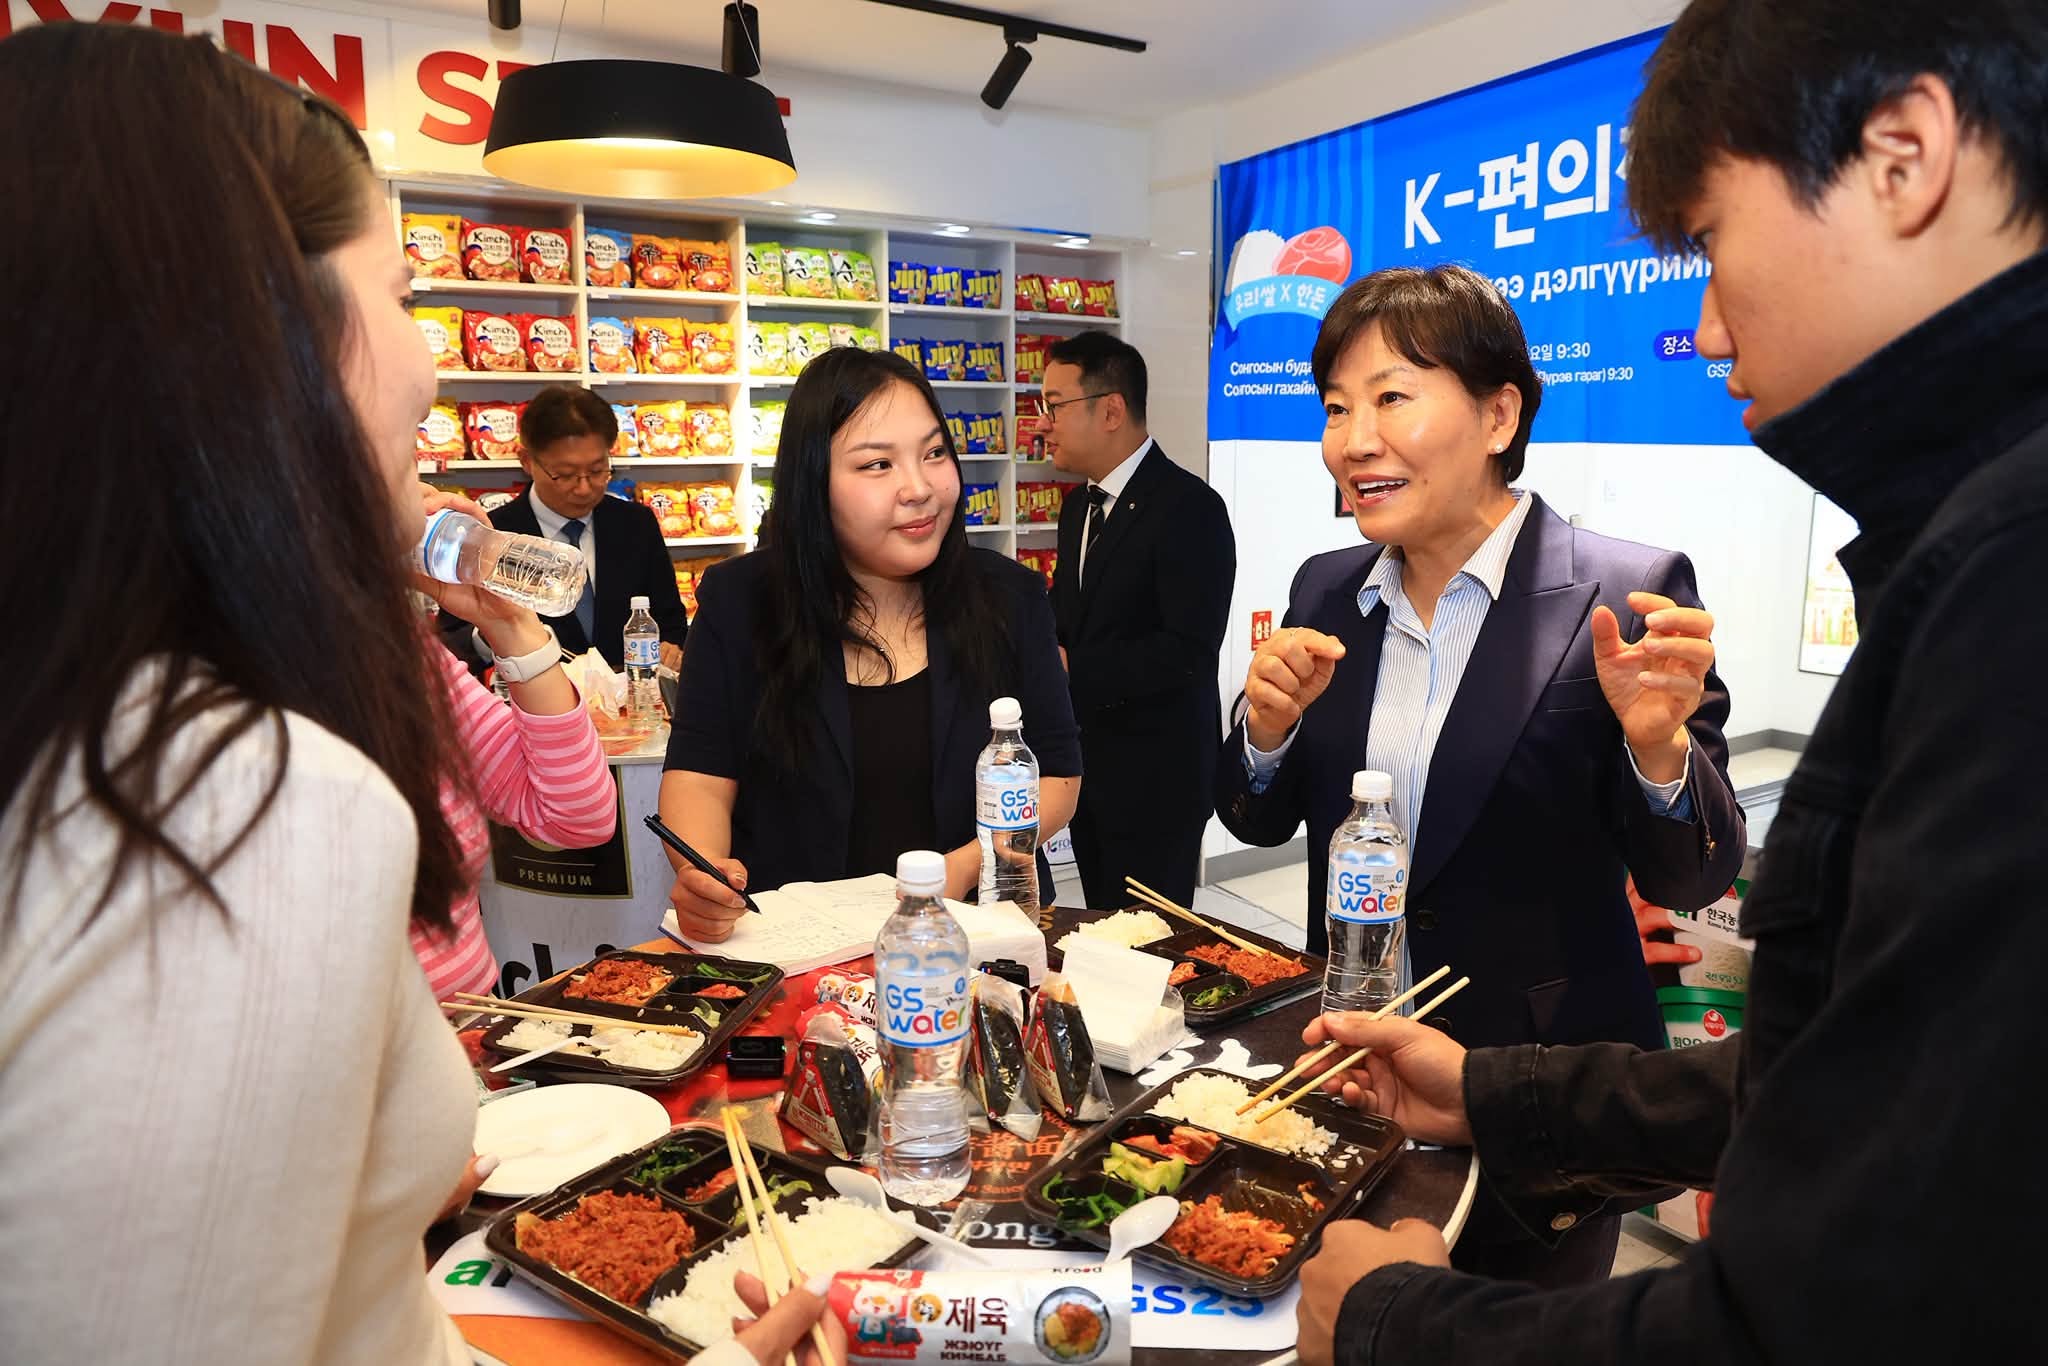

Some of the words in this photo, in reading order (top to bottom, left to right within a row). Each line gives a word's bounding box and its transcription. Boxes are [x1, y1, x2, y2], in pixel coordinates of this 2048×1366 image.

[1404, 123, 1634, 249] K-편의
[1488, 274, 1525, 299] ээ
[1556, 342, 1591, 359] 9:30
[1663, 335, 1692, 355] 장소
[1607, 366, 1634, 381] 9:30
[1001, 788, 1028, 807] GS
[1001, 800, 1039, 822] wat
[519, 867, 593, 887] PREMIUM
[1338, 872, 1372, 895] GS
[1338, 892, 1404, 914] water
[886, 983, 924, 1013] GS
[887, 1004, 966, 1035] water
[945, 1297, 1008, 1335] 제육
